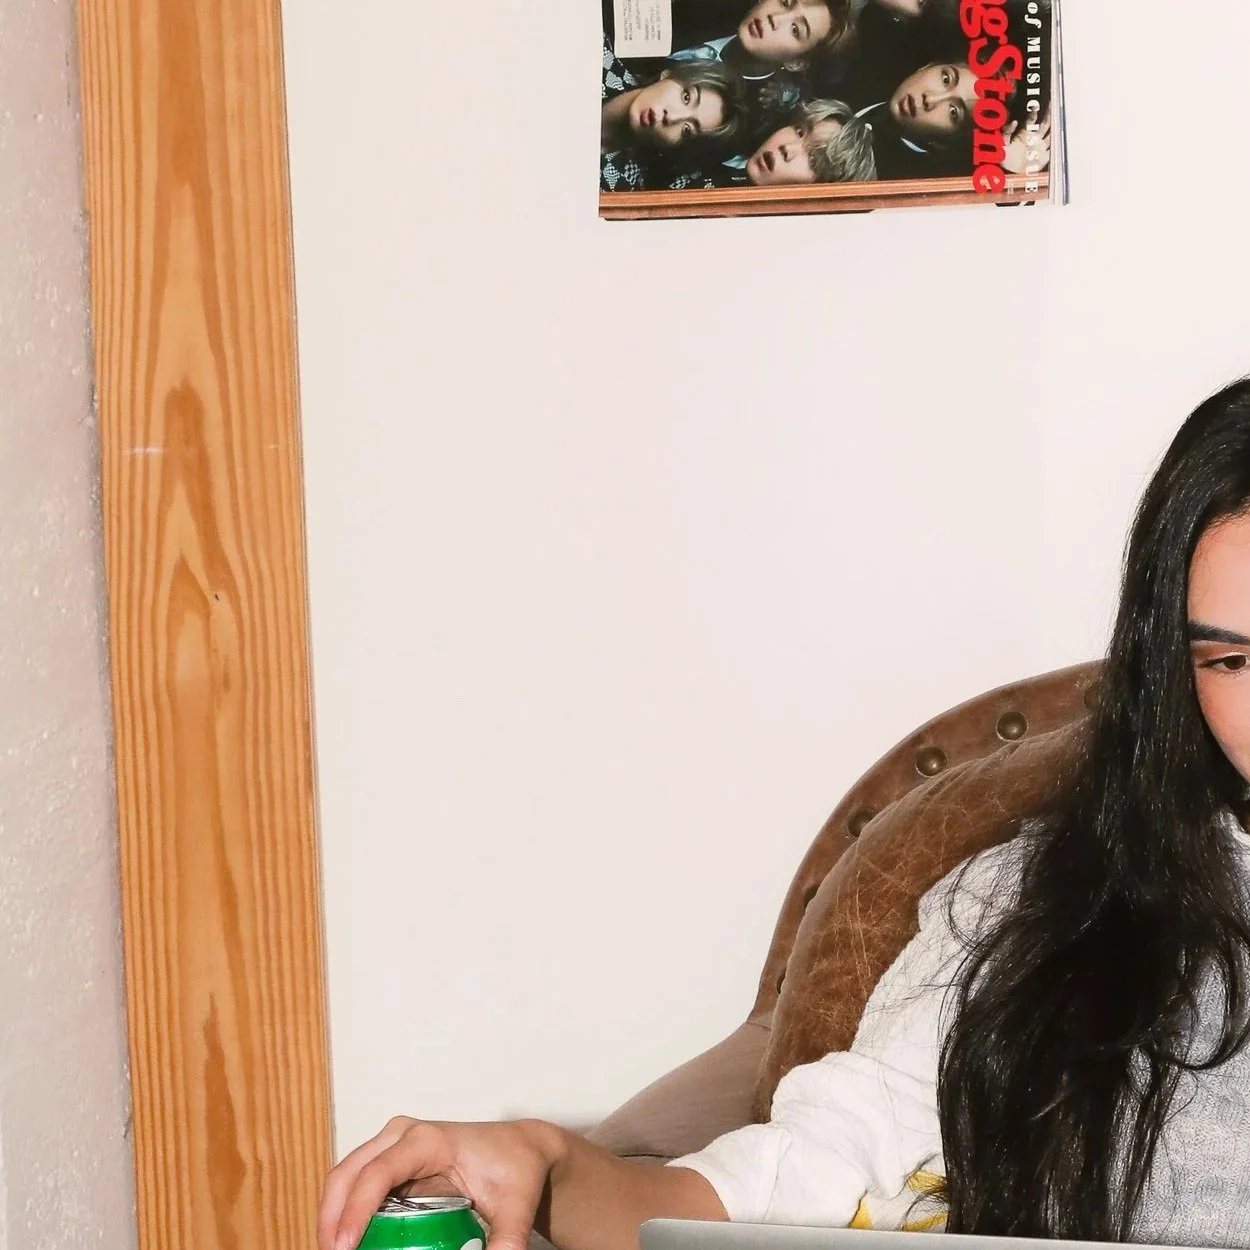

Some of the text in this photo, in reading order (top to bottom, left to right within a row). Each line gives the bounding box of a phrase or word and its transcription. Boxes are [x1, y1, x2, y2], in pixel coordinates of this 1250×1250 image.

[1024, 2, 1042, 194] of MUSIC ISSUE
